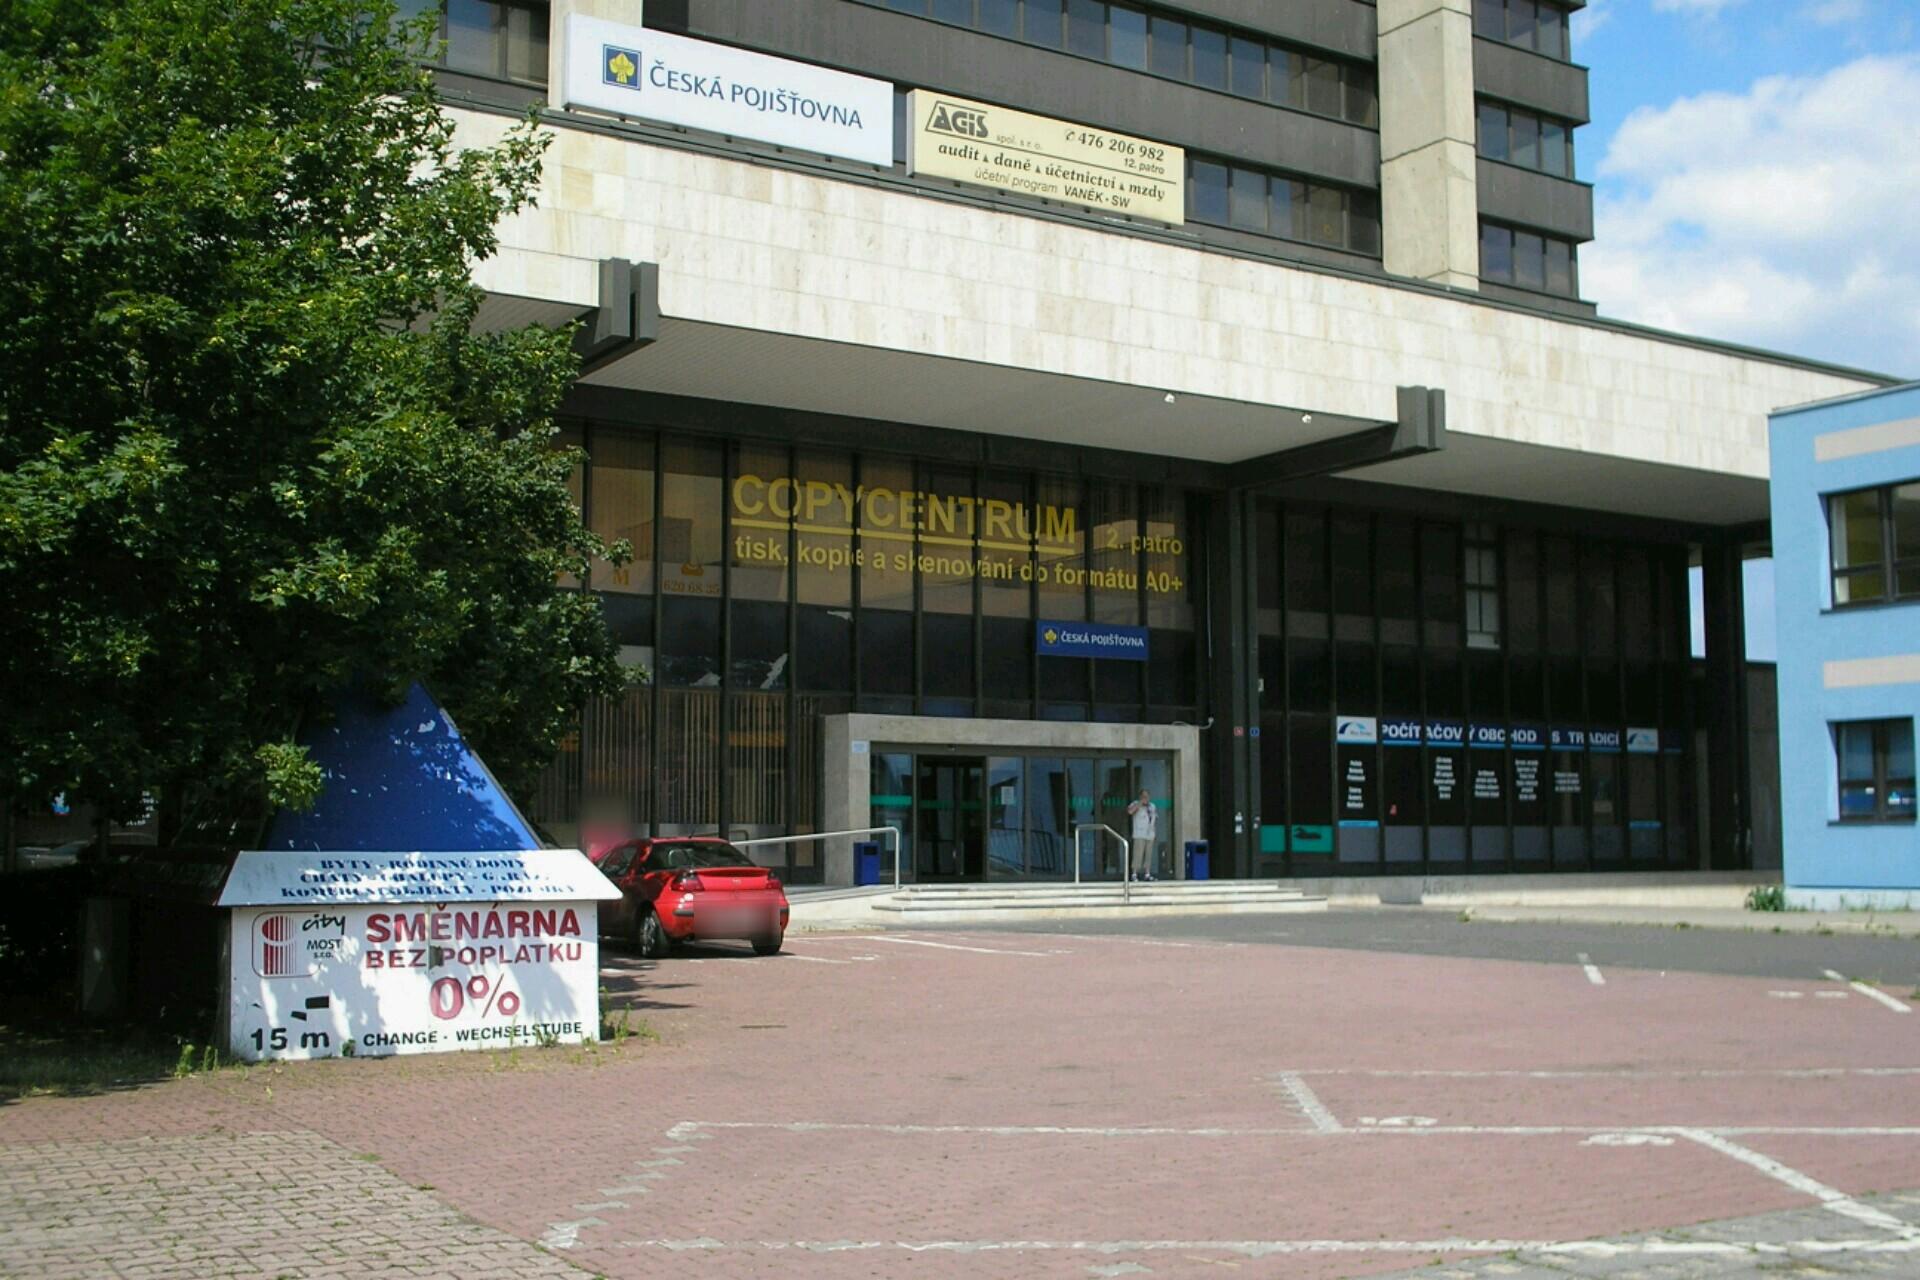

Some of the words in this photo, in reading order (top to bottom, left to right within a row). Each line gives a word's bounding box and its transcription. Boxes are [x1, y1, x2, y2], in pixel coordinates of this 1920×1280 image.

[649, 60, 725, 100] ČESKÁ
[731, 83, 863, 130] POJIŠŤOVNA
[1078, 132, 1104, 149] 476
[1109, 138, 1135, 155] 206
[1138, 145, 1165, 162] 982
[938, 143, 980, 160] audit
[993, 151, 1032, 172] daně
[1045, 163, 1117, 190] účetnictví
[1128, 184, 1166, 202] mzdy
[1124, 157, 1137, 169] 12.
[1139, 161, 1165, 175] patro
[974, 167, 1009, 184] účetní
[1011, 176, 1058, 194] program
[733, 475, 1075, 543] COPYCENTRUM
[1106, 529, 1124, 549] 2.
[1130, 534, 1183, 556] patro
[735, 535, 788, 566] tisk,
[798, 540, 865, 571] kopie
[872, 551, 886, 570] a
[894, 548, 1013, 580] skenování
[1020, 559, 1048, 583] do
[1054, 562, 1138, 591] formátu
[1145, 571, 1183, 593] A0+
[1060, 630, 1090, 644] ČESKÁ
[1091, 633, 1145, 648] POJIŠŤOVNA
[475, 859, 526, 869] DOMY
[302, 913, 346, 936] city
[366, 903, 582, 943] SMĚNÁRNA
[306, 939, 343, 950] MOST
[366, 949, 427, 969] BEZ
[441, 943, 582, 967] POPLATKU
[429, 973, 520, 1020] 0%
[250, 1027, 288, 1051] 15
[301, 1031, 330, 1049] m
[363, 1030, 438, 1047] CHANGE
[456, 1021, 583, 1042] WECHSELSTUBE
